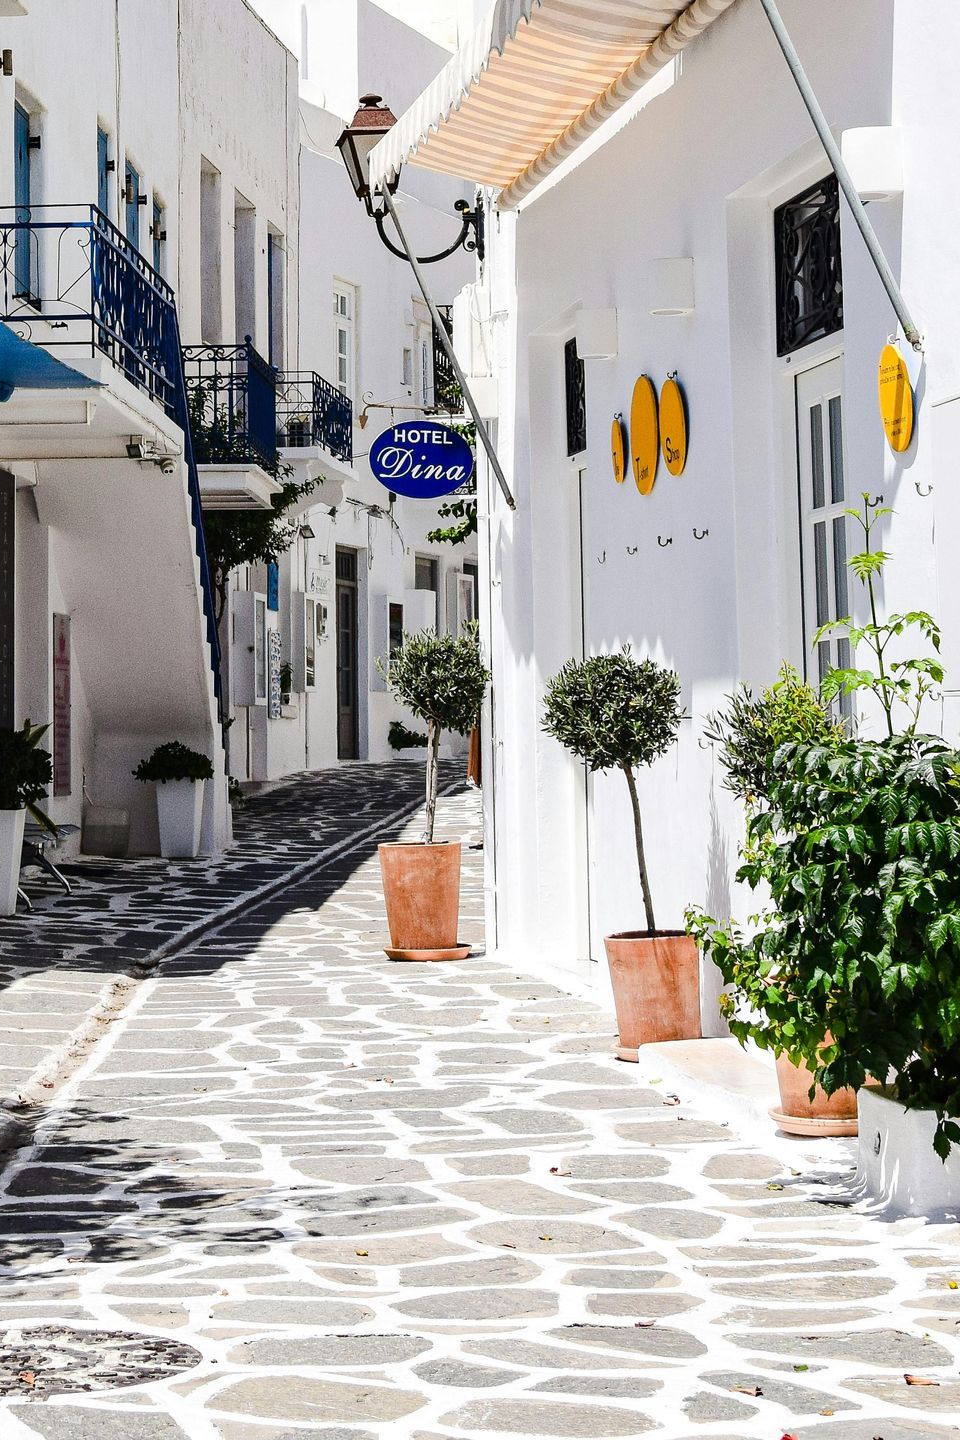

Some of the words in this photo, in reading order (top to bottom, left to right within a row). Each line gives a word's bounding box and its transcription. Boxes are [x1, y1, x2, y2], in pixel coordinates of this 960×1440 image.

[394, 428, 453, 445] HOTEL
[665, 436, 680, 464] Shop
[376, 446, 466, 480] Dina
